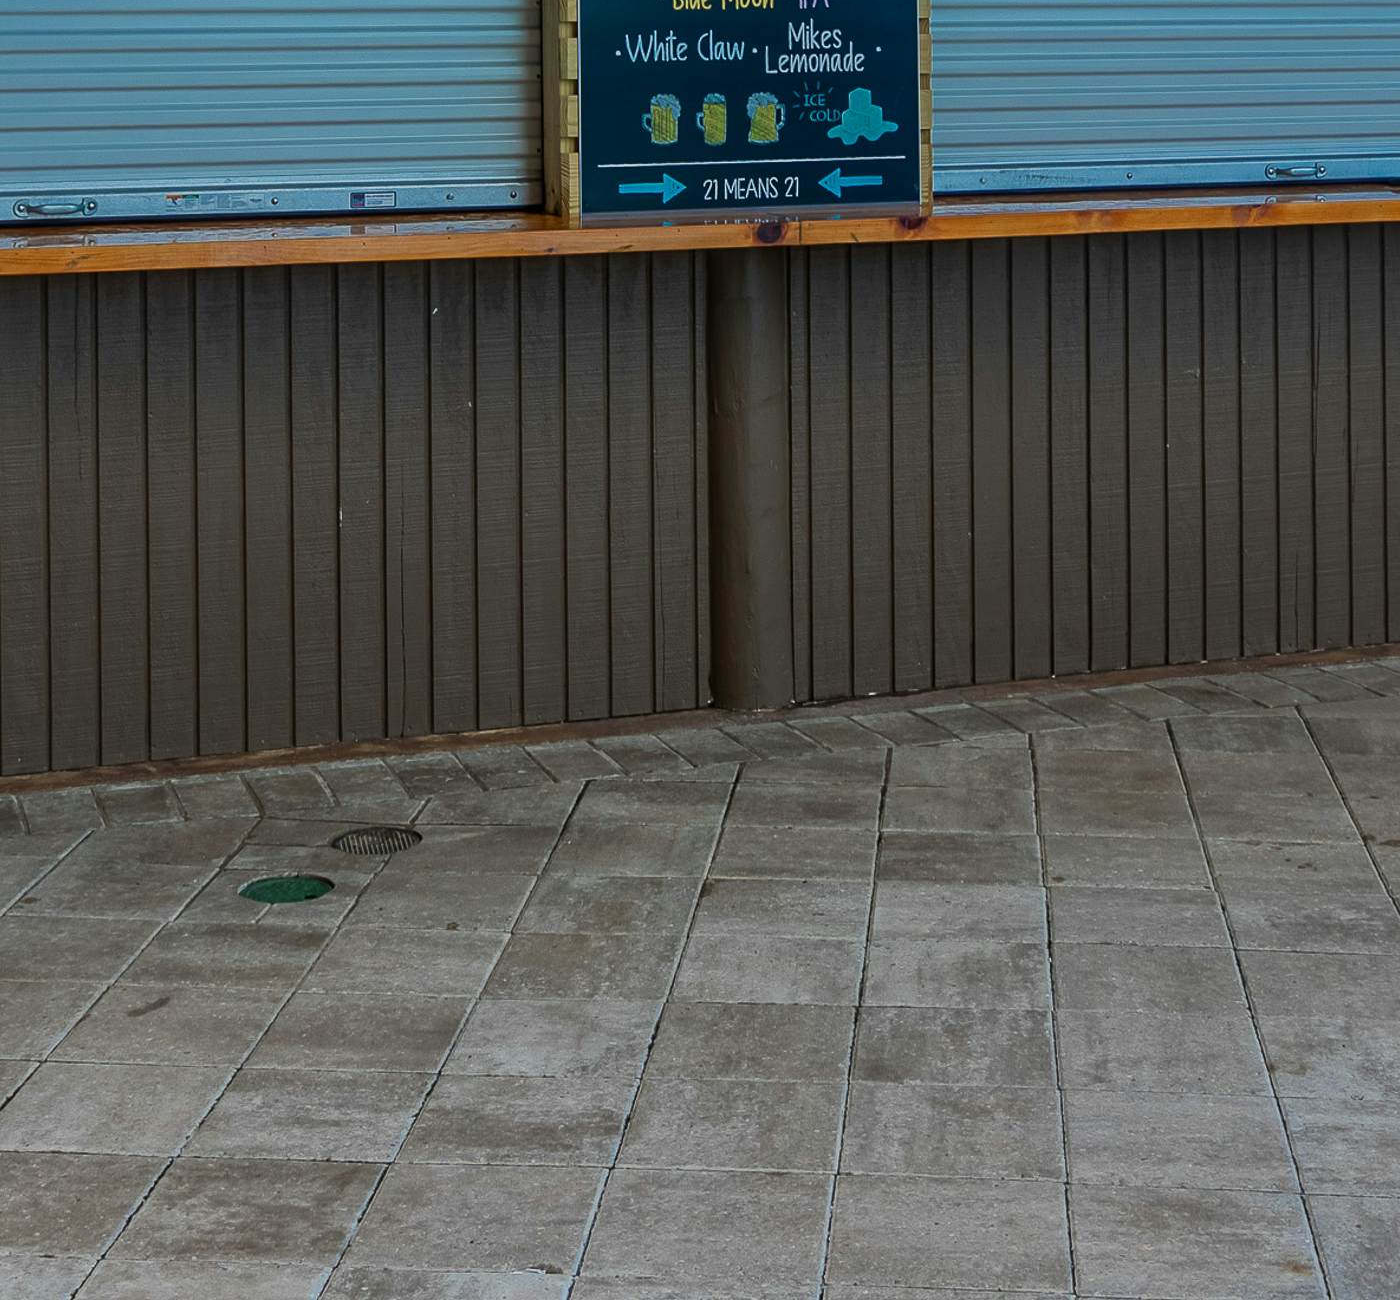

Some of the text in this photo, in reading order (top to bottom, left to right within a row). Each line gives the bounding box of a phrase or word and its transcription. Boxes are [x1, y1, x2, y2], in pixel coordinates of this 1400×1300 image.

[626, 30, 744, 62] White Claw
[788, 18, 841, 49] Mikes
[765, 42, 864, 74] Lemonade
[804, 94, 825, 106] ICE
[810, 111, 840, 122] COLD
[703, 177, 799, 200] 21 MEANS 21
